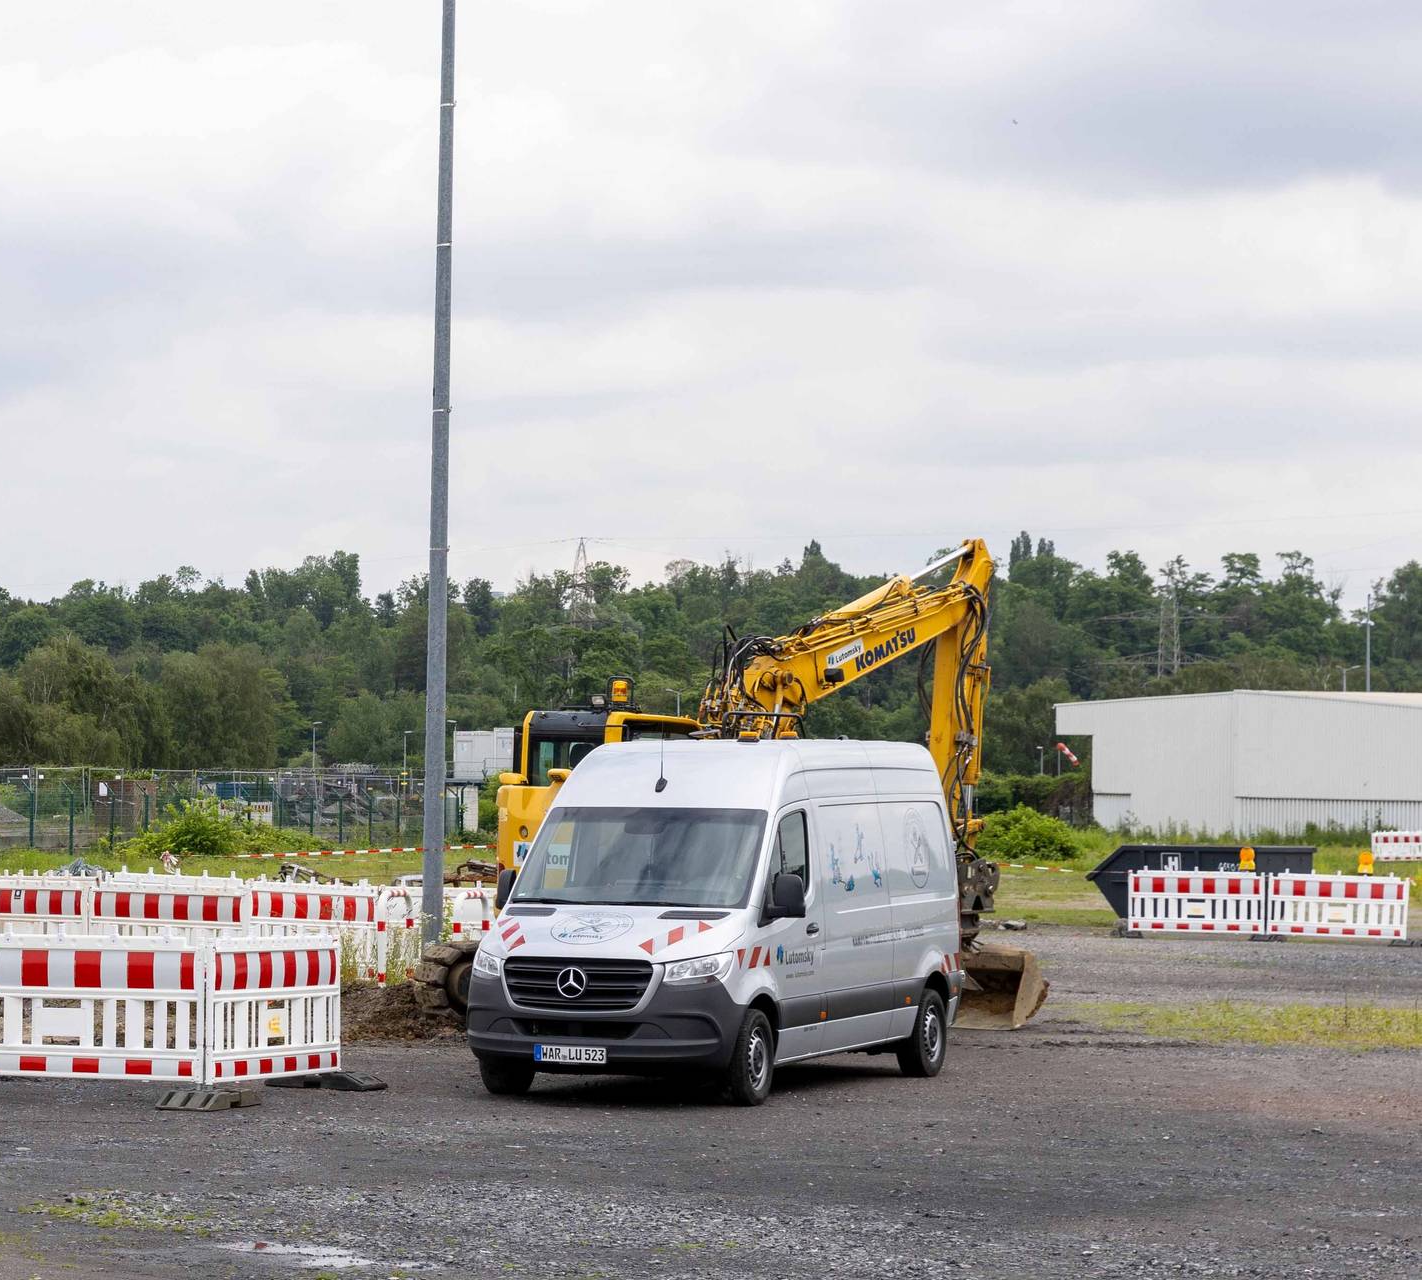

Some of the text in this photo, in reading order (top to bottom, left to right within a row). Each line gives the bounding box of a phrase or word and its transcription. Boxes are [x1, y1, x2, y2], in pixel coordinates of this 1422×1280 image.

[835, 644, 861, 663] Lutomsky
[855, 627, 916, 672] KOMATSU
[785, 947, 814, 966] Lutomsky
[584, 1048, 605, 1062] 523
